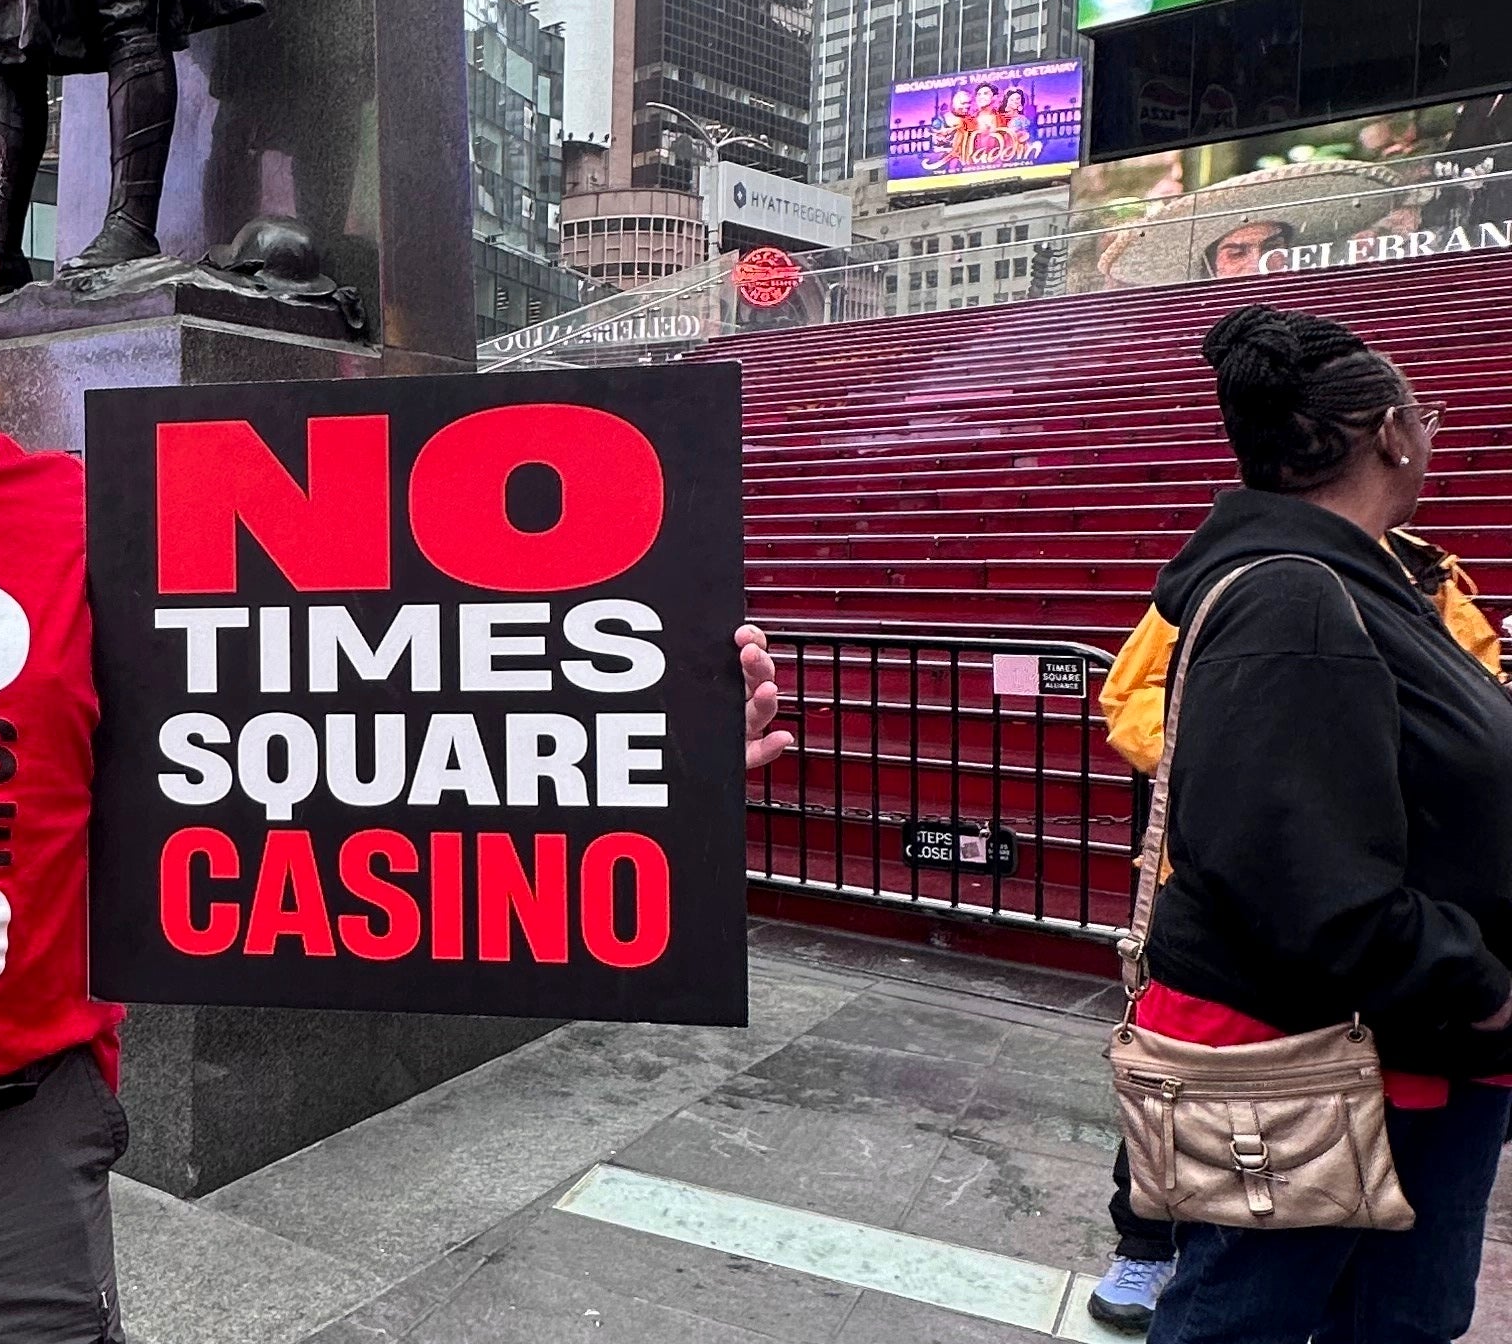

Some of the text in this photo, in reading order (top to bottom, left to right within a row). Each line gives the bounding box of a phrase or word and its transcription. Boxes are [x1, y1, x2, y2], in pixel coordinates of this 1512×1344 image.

[894, 61, 1078, 94] BROADWAY'S MAGICAL GETAWAY
[921, 126, 1044, 171] Aladdin
[751, 190, 843, 229] HYATT REGENCY
[155, 402, 665, 595] NO
[153, 597, 667, 694] TIMES
[1045, 663, 1078, 673] TIMES
[1042, 672, 1081, 682] SQUARE
[157, 711, 670, 822] SQUARE
[159, 825, 671, 969] CASINO
